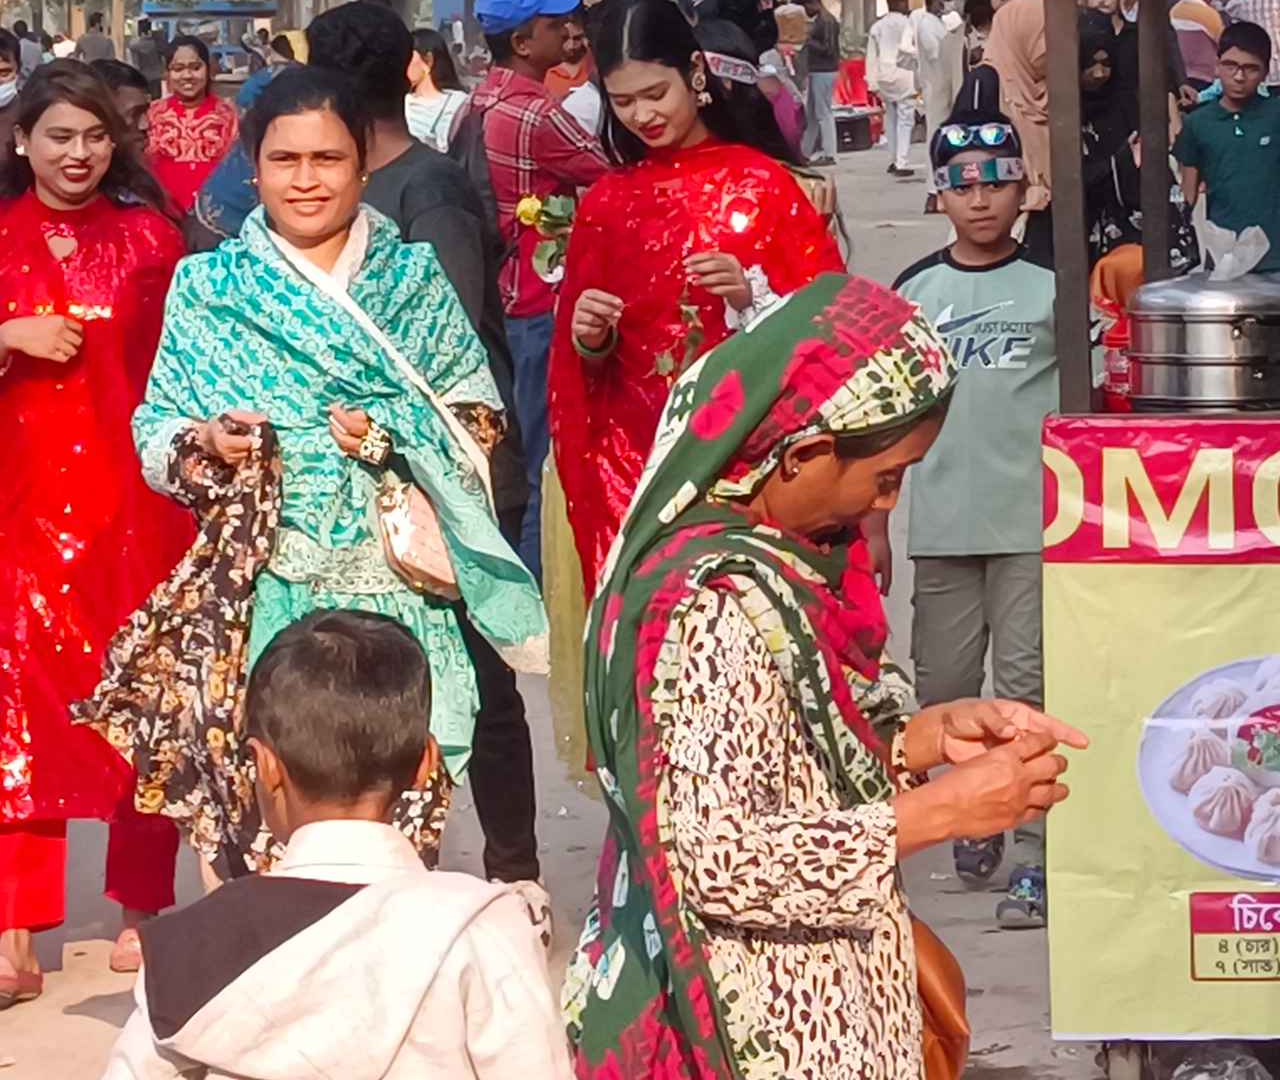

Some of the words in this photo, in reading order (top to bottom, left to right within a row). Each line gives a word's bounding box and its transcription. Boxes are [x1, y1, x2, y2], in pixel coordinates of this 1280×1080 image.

[941, 335, 1037, 369] IKE
[1218, 938, 1229, 954] ৪
[1236, 936, 1279, 956] (চার)
[1215, 960, 1226, 974] ৭
